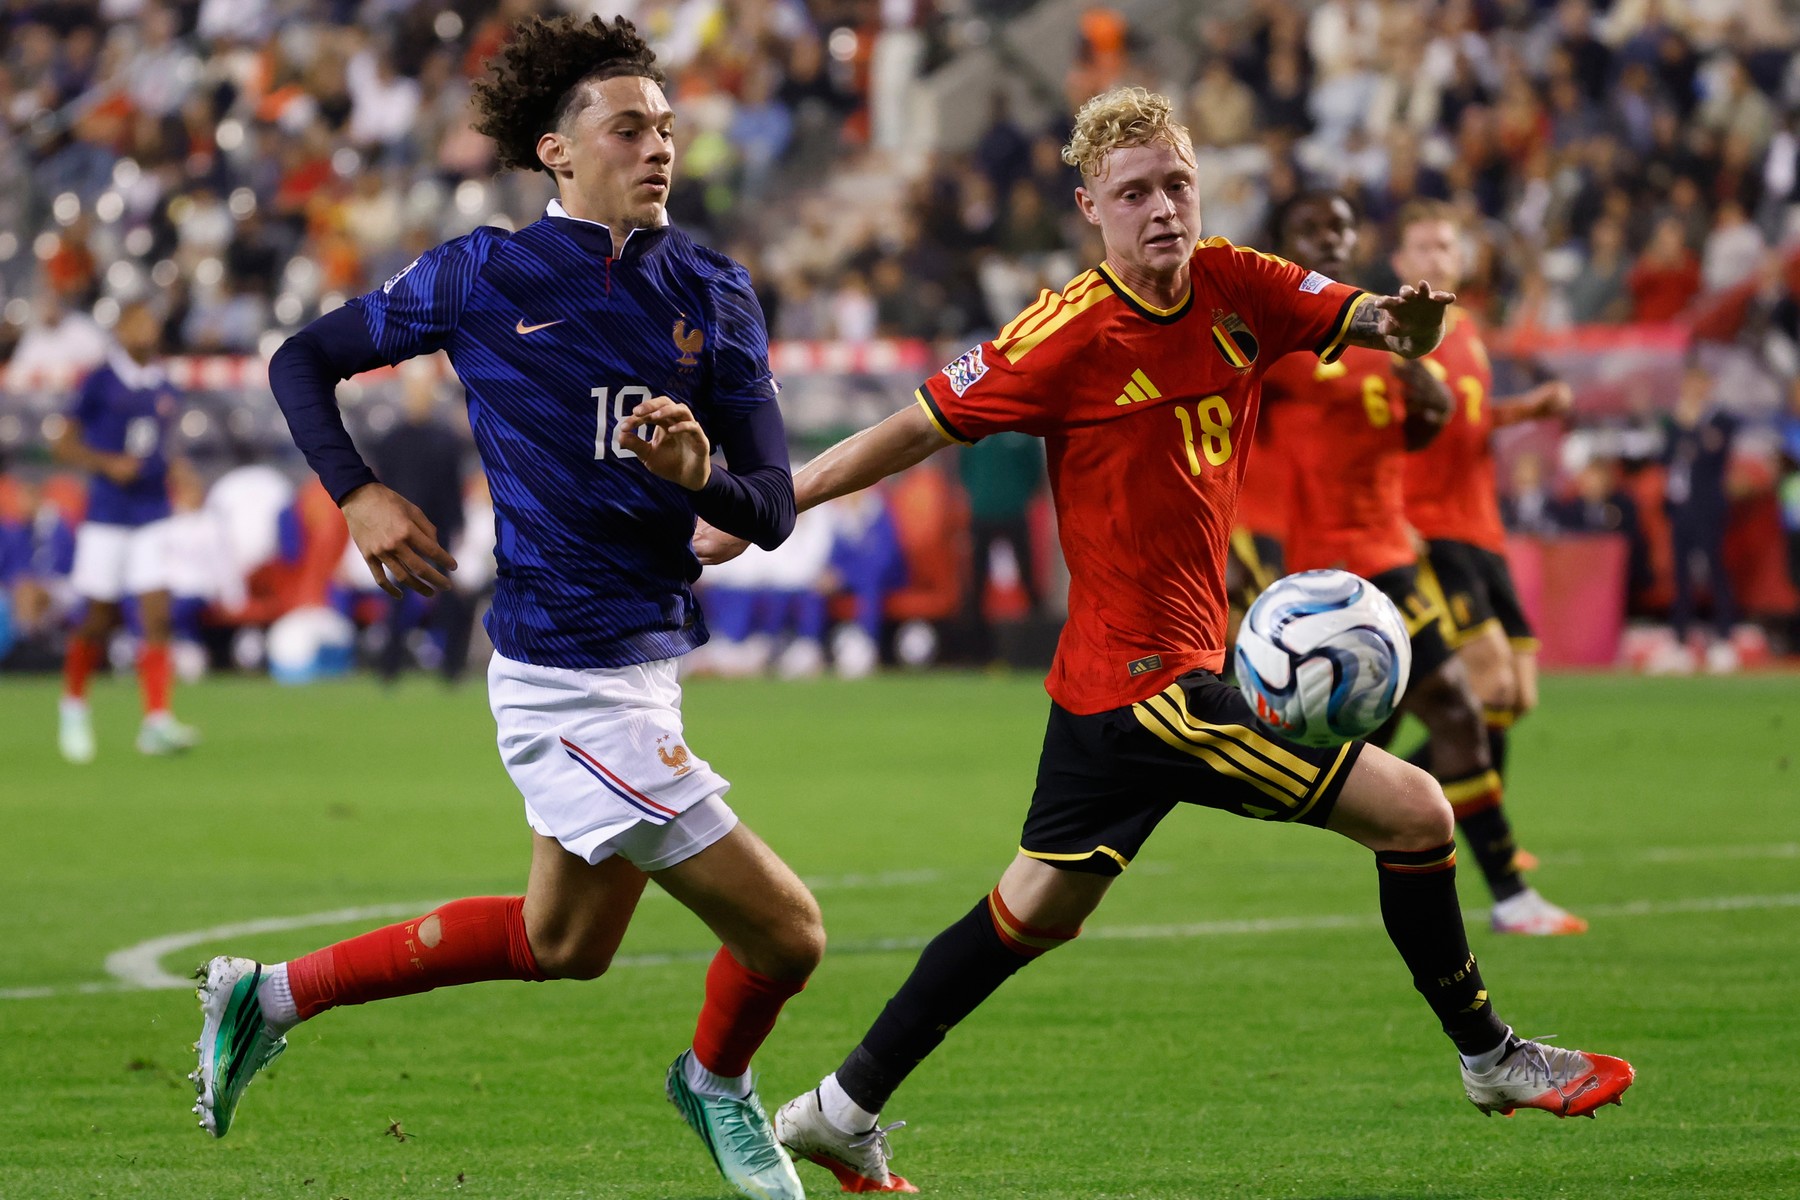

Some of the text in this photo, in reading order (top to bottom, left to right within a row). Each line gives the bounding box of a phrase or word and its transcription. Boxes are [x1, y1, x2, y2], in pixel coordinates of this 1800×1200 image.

[590, 385, 653, 460] 18
[1363, 375, 1391, 428] 6
[1175, 395, 1232, 476] 18
[404, 923, 424, 971] FFF
